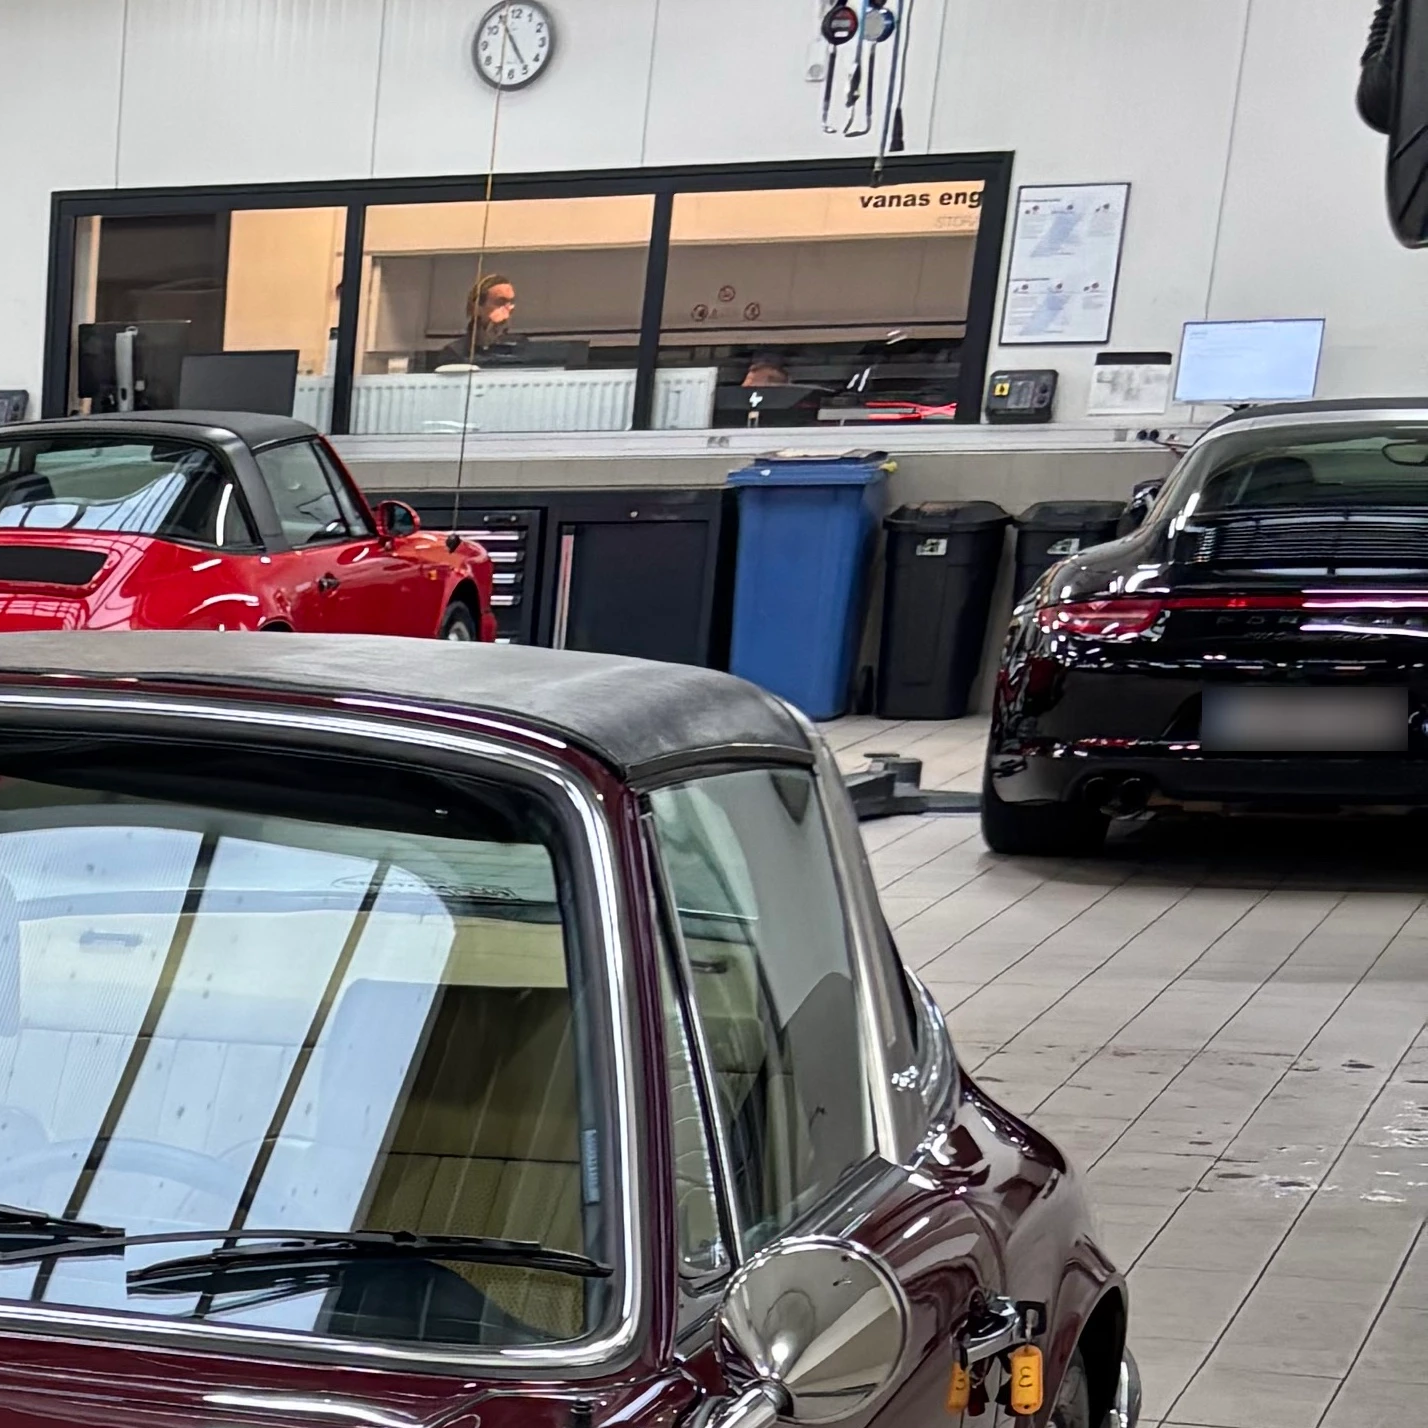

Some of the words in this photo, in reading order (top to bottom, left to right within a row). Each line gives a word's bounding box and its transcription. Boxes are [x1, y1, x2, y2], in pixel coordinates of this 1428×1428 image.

[511, 9, 523, 19] 12
[527, 13, 533, 22] 1
[487, 25, 499, 36] 10
[536, 22, 543, 33] 2
[481, 41, 489, 51] 9
[538, 37, 546, 47] 3
[484, 56, 492, 66] 8
[533, 53, 540, 62] 4
[495, 66, 502, 75] 7
[507, 69, 514, 79] 6
[522, 64, 529, 75] 5
[860, 192, 930, 208] vanas
[939, 190, 982, 208] eng
